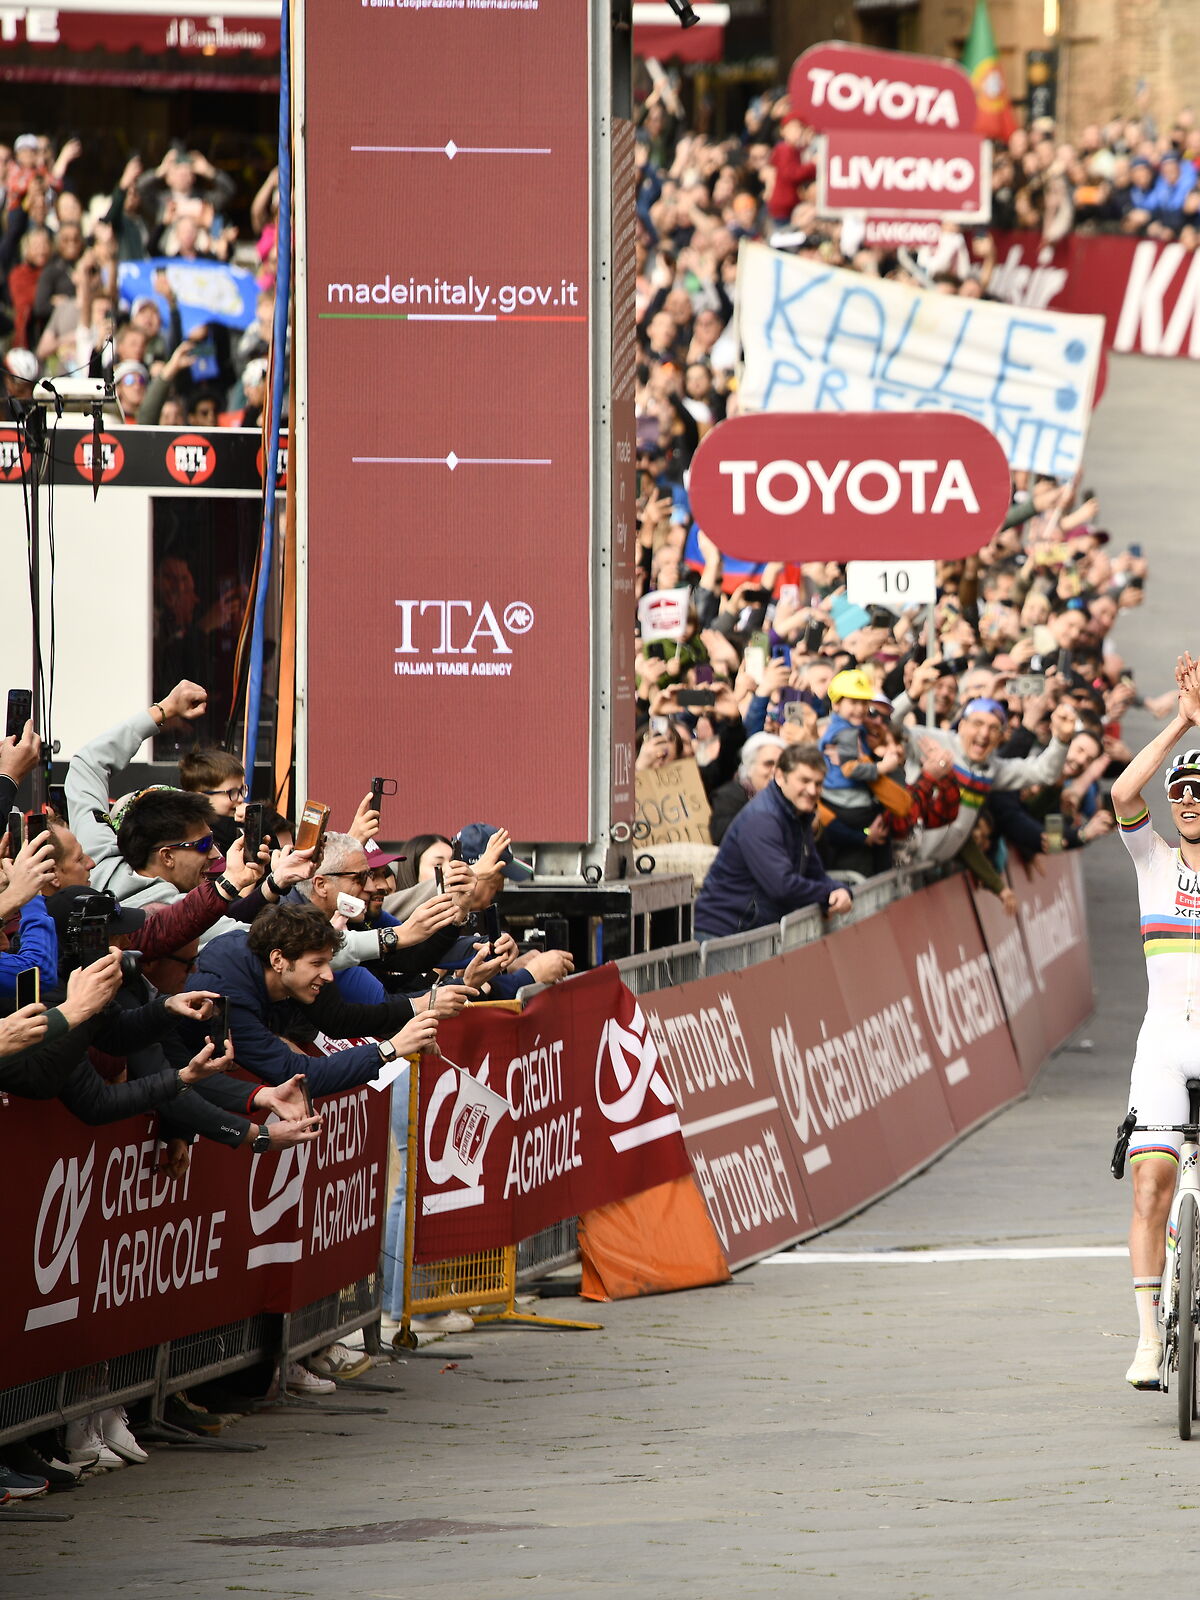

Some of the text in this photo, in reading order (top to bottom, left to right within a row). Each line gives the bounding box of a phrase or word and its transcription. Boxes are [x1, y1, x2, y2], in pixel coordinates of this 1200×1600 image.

[808, 67, 960, 128] TOYOTA
[829, 155, 975, 193] LIVIGNO
[327, 274, 578, 313] madeinitaly.gov.it
[718, 458, 981, 516] TOYOTA
[878, 570, 910, 593] 10
[395, 600, 513, 654] ITA
[394, 662, 512, 676] ITALIAN TRADE AGENCY
[505, 1033, 564, 1122] CRÉDIT
[805, 1019, 876, 1131] CRÉDIT
[503, 1105, 583, 1200] AGRICOLE
[310, 1162, 379, 1255] AGRICOLE
[92, 1210, 226, 1314] AGRICOLE
